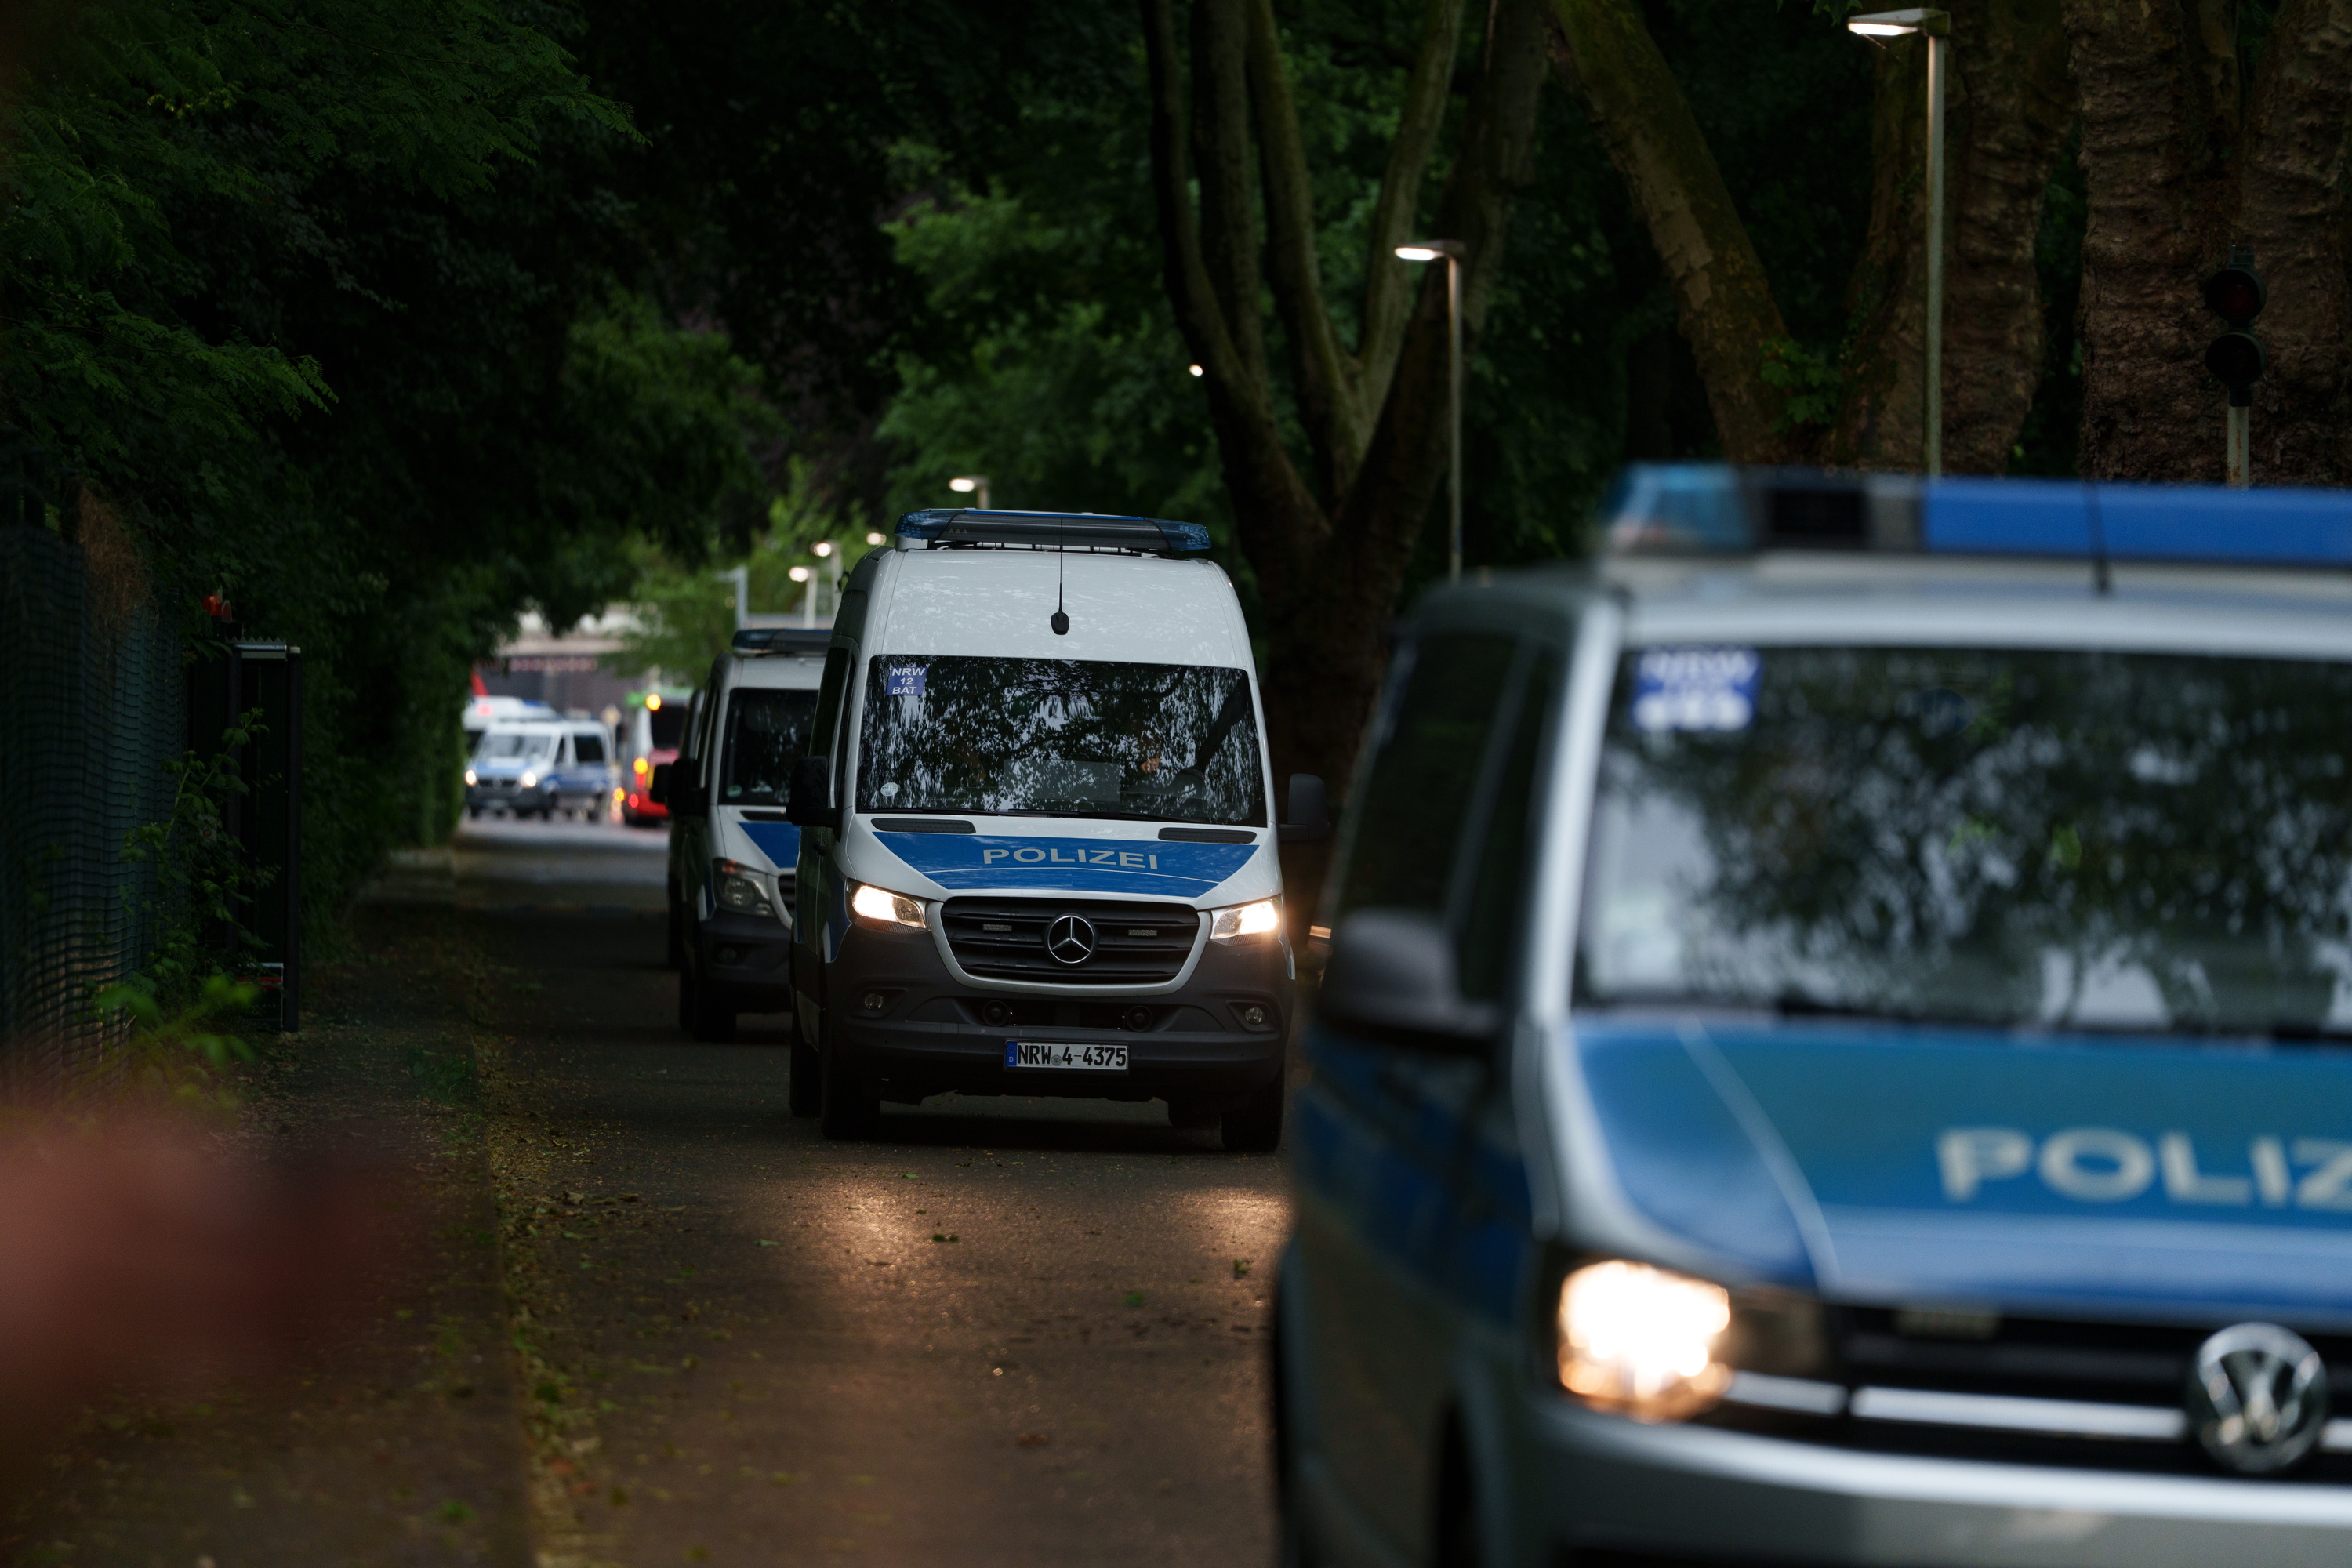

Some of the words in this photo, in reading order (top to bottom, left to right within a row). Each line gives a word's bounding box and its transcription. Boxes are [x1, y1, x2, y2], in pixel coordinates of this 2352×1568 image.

[891, 667, 926, 676] NRW
[982, 848, 1159, 870] POLIZEI
[1018, 1045, 1051, 1065] NRW
[1062, 1046, 1127, 1066] 4-4375
